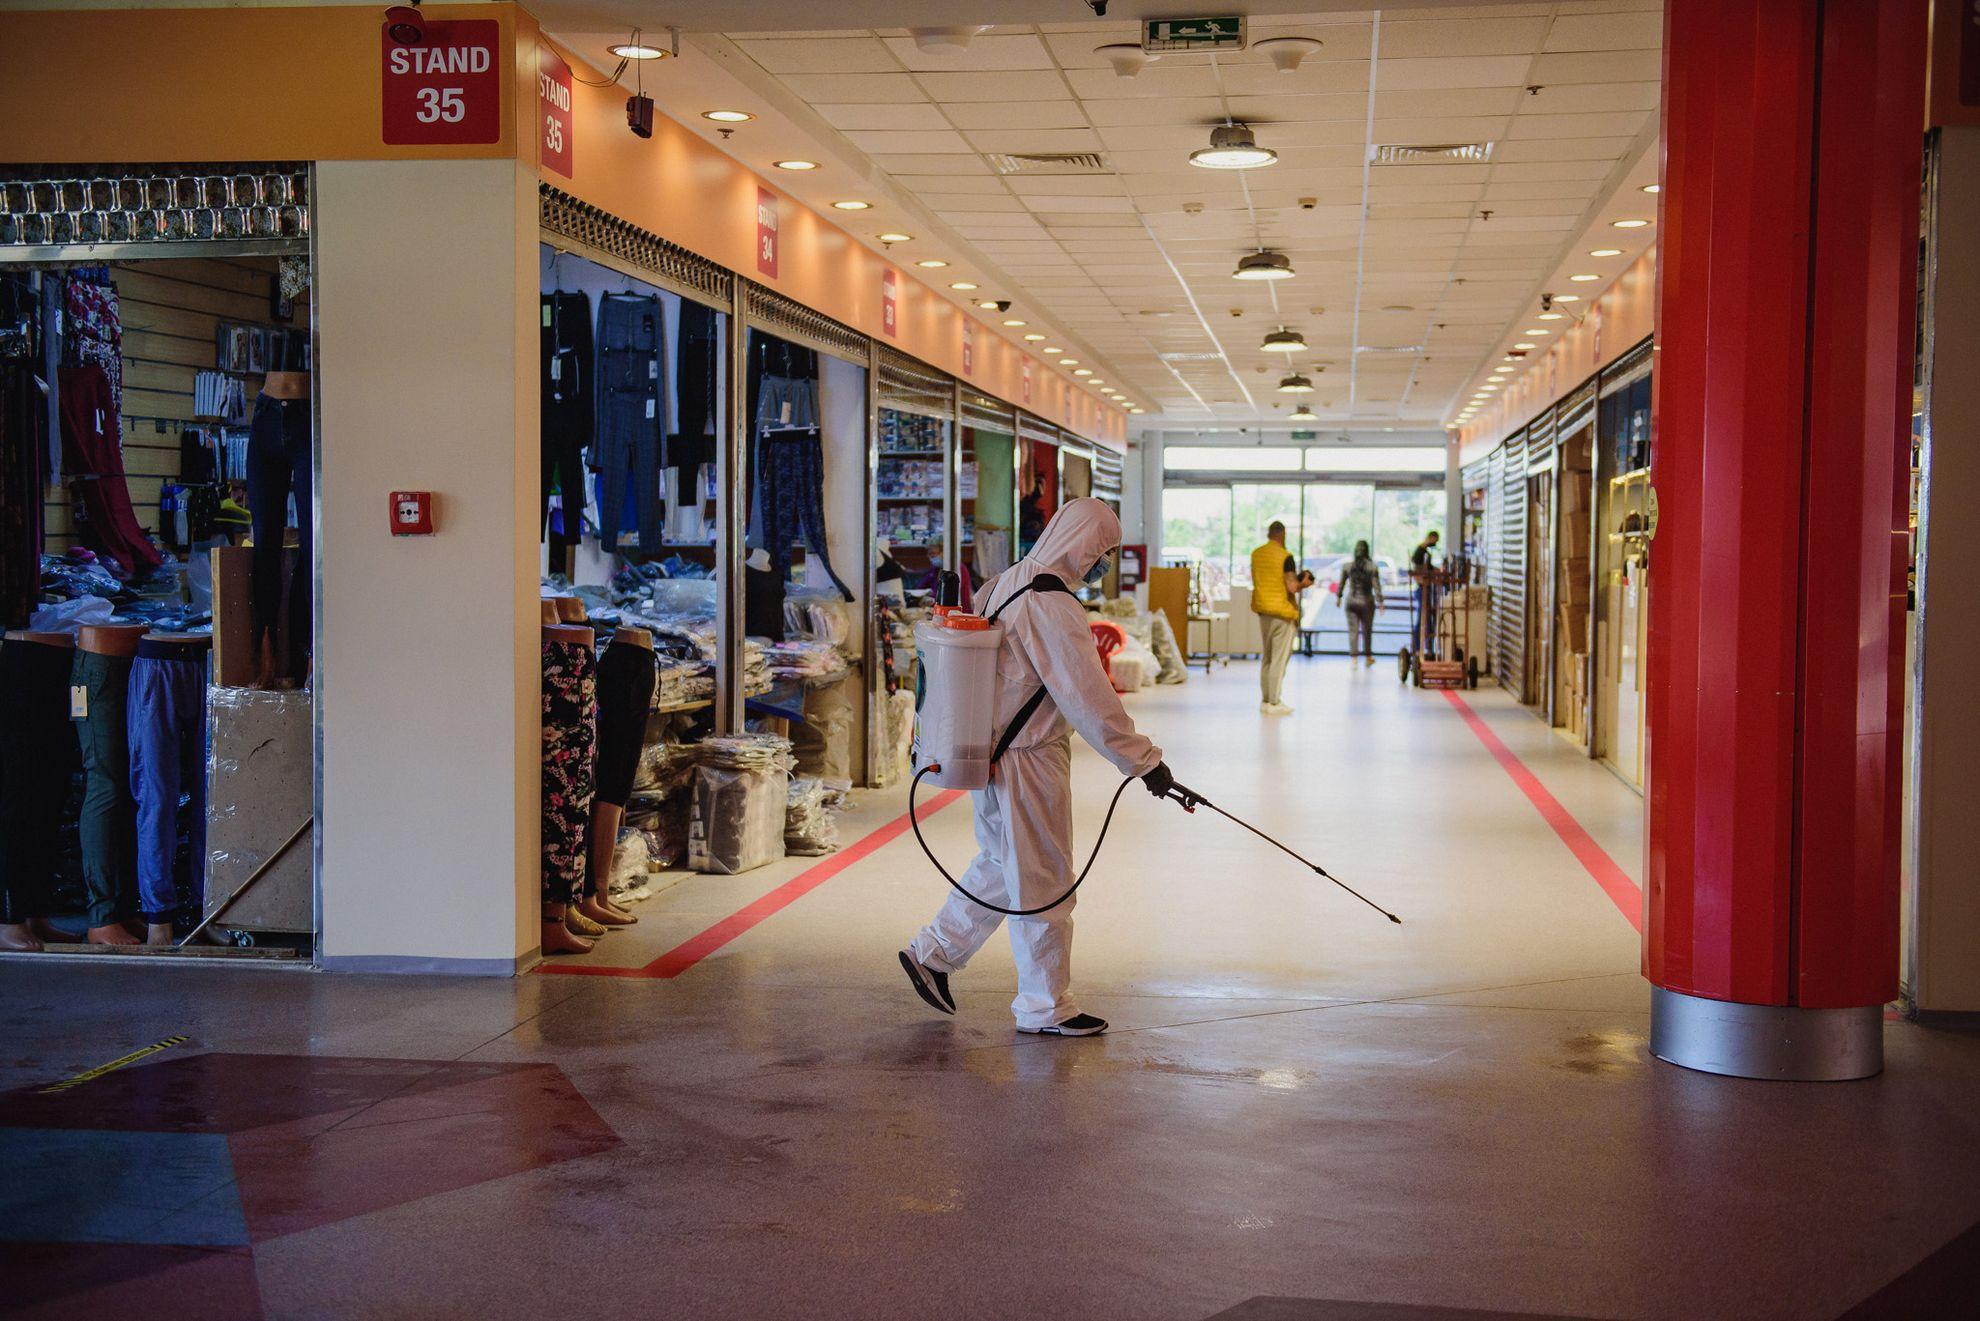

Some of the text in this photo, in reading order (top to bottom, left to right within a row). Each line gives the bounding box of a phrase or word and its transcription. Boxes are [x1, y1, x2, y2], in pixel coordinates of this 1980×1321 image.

[390, 46, 490, 75] STAND
[416, 87, 466, 123] 35
[539, 71, 570, 113] STAND
[546, 115, 563, 154] 35
[762, 235, 773, 262] 34
